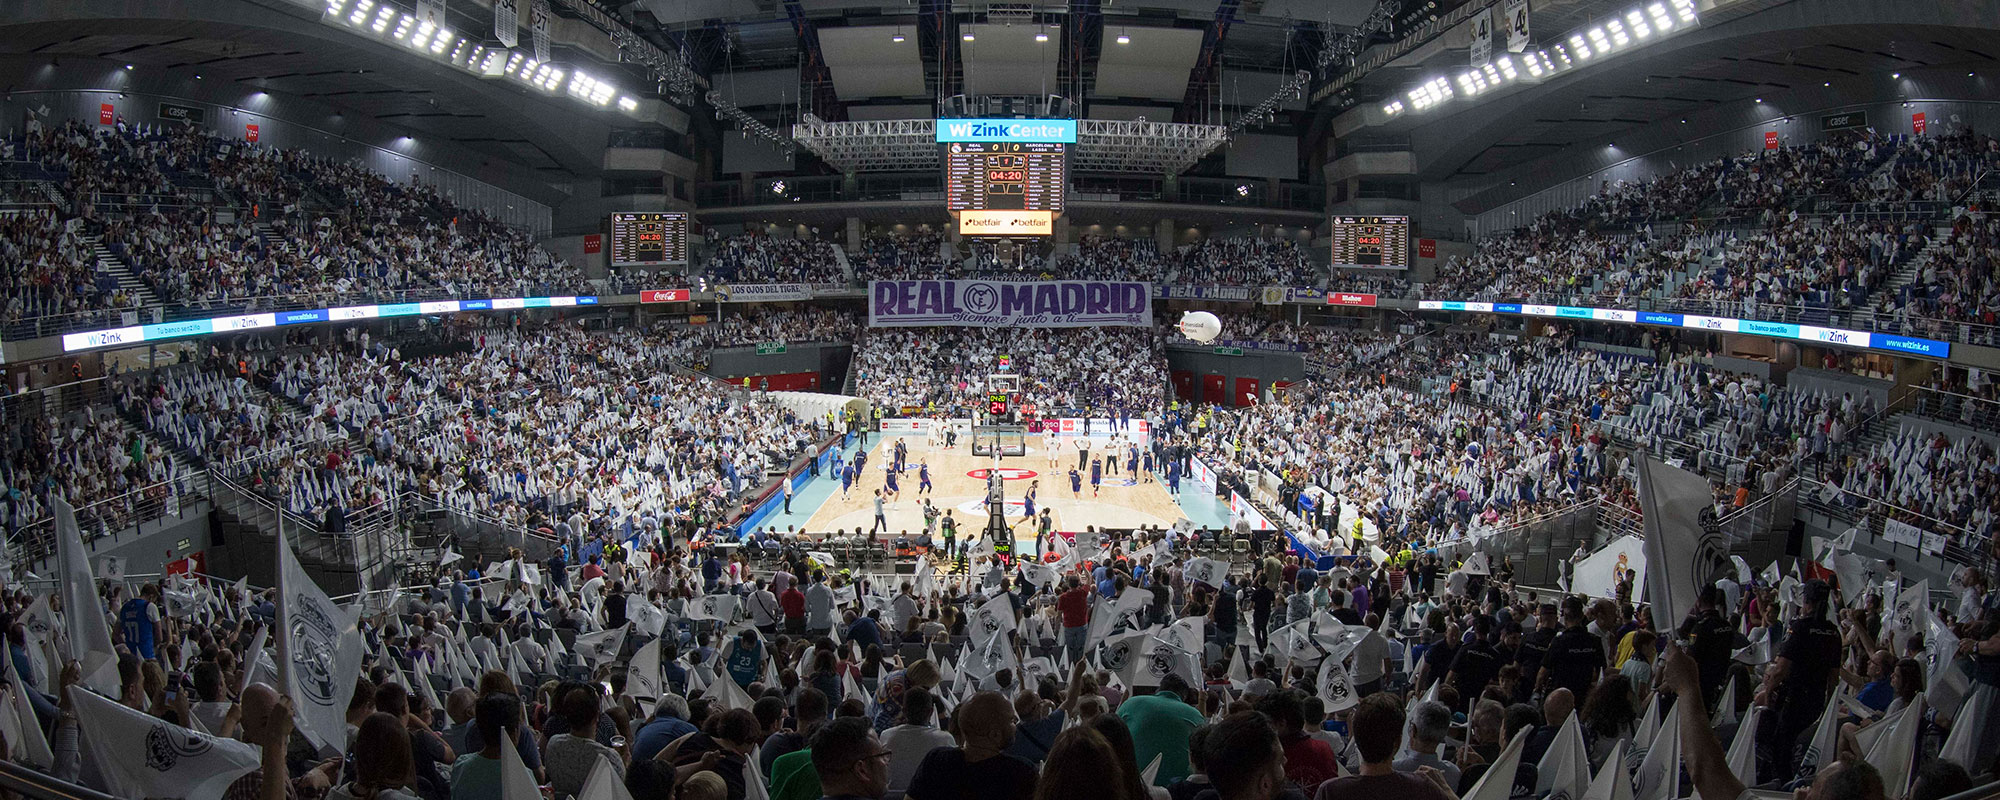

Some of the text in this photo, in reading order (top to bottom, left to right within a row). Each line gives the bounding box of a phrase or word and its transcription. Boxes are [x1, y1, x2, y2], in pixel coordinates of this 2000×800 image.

[536, 12, 547, 31] 27
[168, 107, 189, 118] caser
[1830, 115, 1849, 127] caser
[990, 171, 1022, 180] 04:20
[973, 218, 1001, 226] betfair
[1018, 218, 1048, 226] betfair
[731, 284, 800, 294] LOS OJOS DEL TIGRE
[1169, 286, 1199, 298] REAL
[1202, 287, 1249, 299] MADRID
[875, 281, 1146, 316] REAL MADRID
[231, 318, 258, 329] WiZink
[951, 312, 1008, 325] Siempre
[1010, 314, 1049, 328] junto
[1066, 311, 1078, 322] ti
[1699, 318, 1722, 329] WiZink
[157, 327, 165, 335] Tu
[165, 326, 181, 334] banco
[1755, 324, 1770, 332] banco
[87, 332, 122, 346] WiZink
[1818, 330, 1849, 343] WiZink
[1231, 340, 1253, 348] REAL
[1258, 341, 1289, 351] MADRID
[1886, 339, 1930, 352] www.wizink.es
[991, 402, 1005, 413] 24
[739, 656, 752, 666] 23
